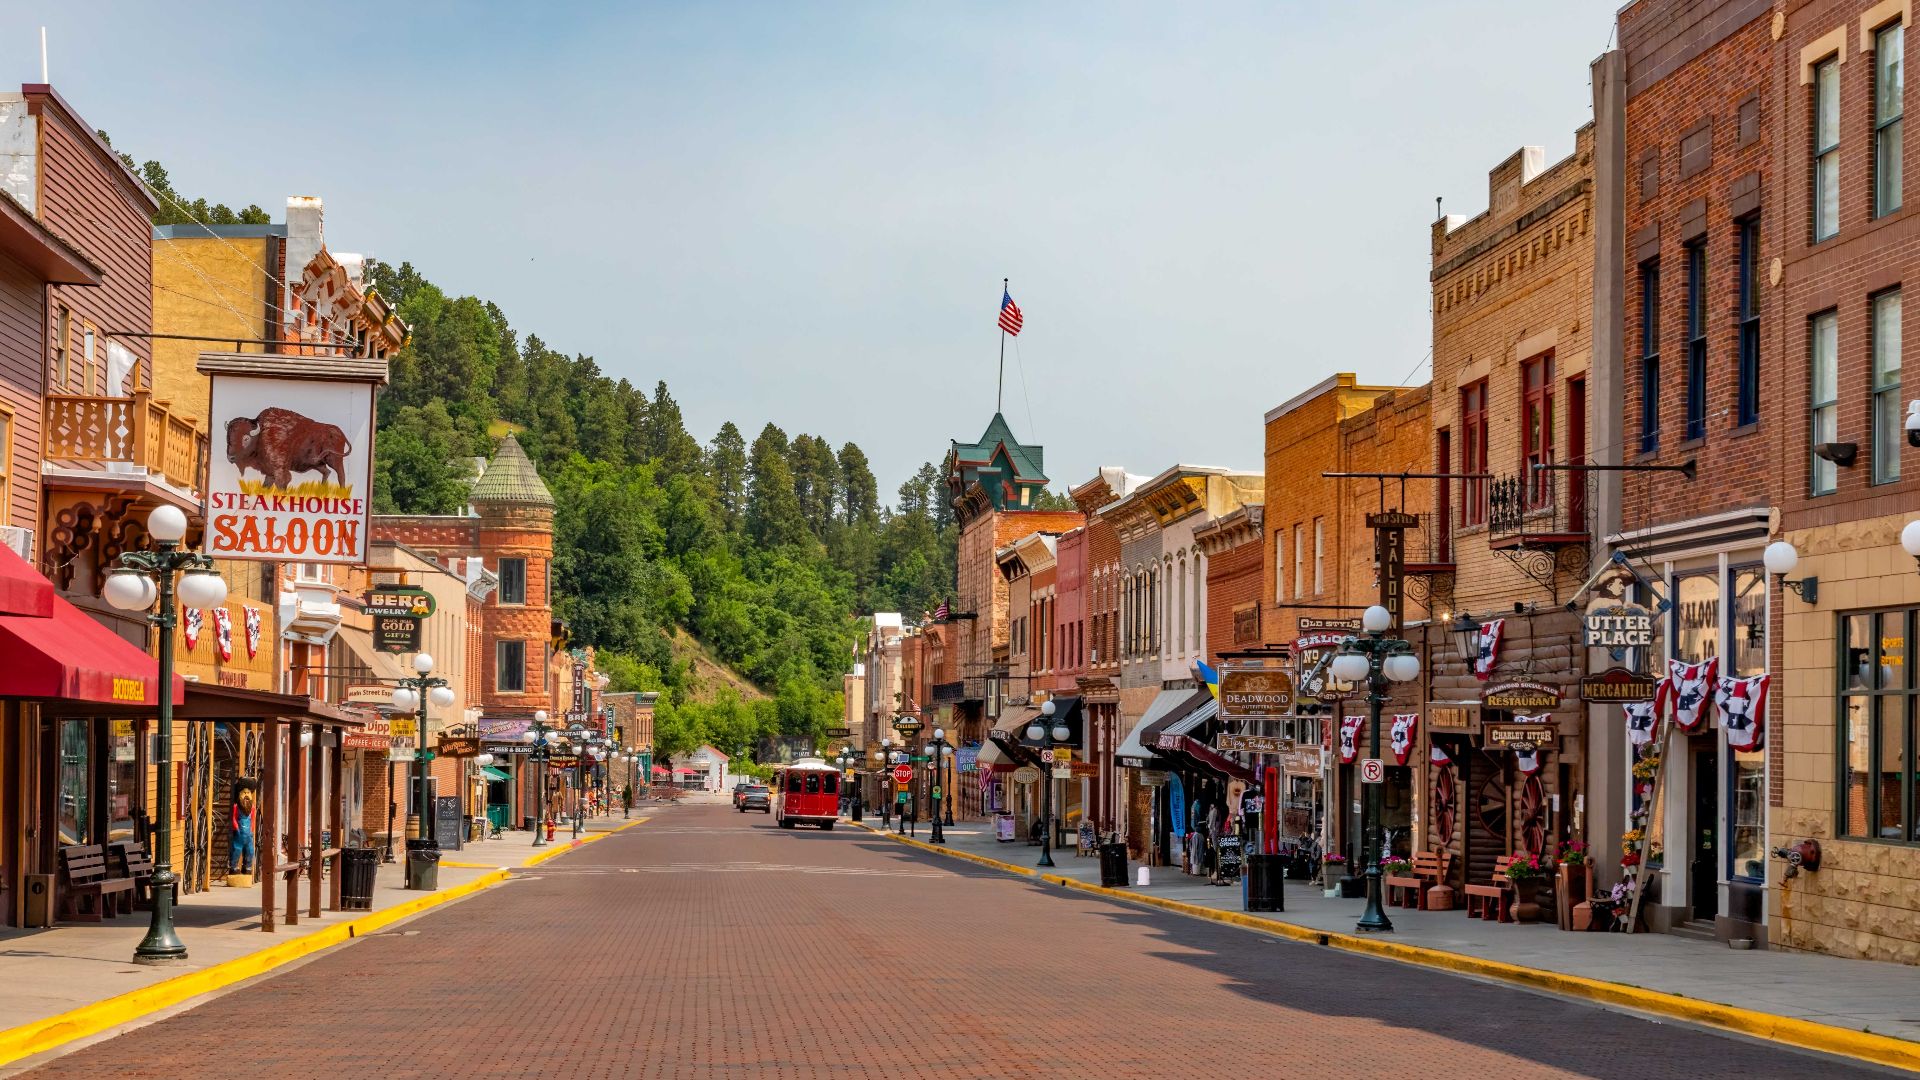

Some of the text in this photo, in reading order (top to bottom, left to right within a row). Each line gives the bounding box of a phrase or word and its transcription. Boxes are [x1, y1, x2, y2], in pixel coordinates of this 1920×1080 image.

[212, 492, 364, 515] STEAKHOUSE
[1390, 513, 1414, 524] STYLE
[213, 515, 359, 557] SALOON
[1389, 531, 1398, 630] SALOON
[371, 594, 427, 608] BERG
[381, 623, 415, 631] GOLD
[1301, 619, 1361, 629] OLD STYLE
[1588, 616, 1651, 630] UTTER
[1588, 631, 1651, 645] PLACE
[112, 678, 145, 701] BODEGA
[1521, 682, 1542, 690] SOCIAL
[1543, 686, 1559, 696] CLUB
[1585, 683, 1653, 698] MERCANTILE
[1227, 694, 1289, 703] DEADWOOD
[1488, 695, 1558, 706] RESTAURANT
[567, 714, 588, 722] BAR
[368, 721, 390, 735] Dipp
[1492, 730, 1552, 741] CHARLEY UTTER
[1228, 738, 1246, 750] Tipsy
[1247, 739, 1275, 750] Buffalo
[1275, 742, 1290, 752] Bar
